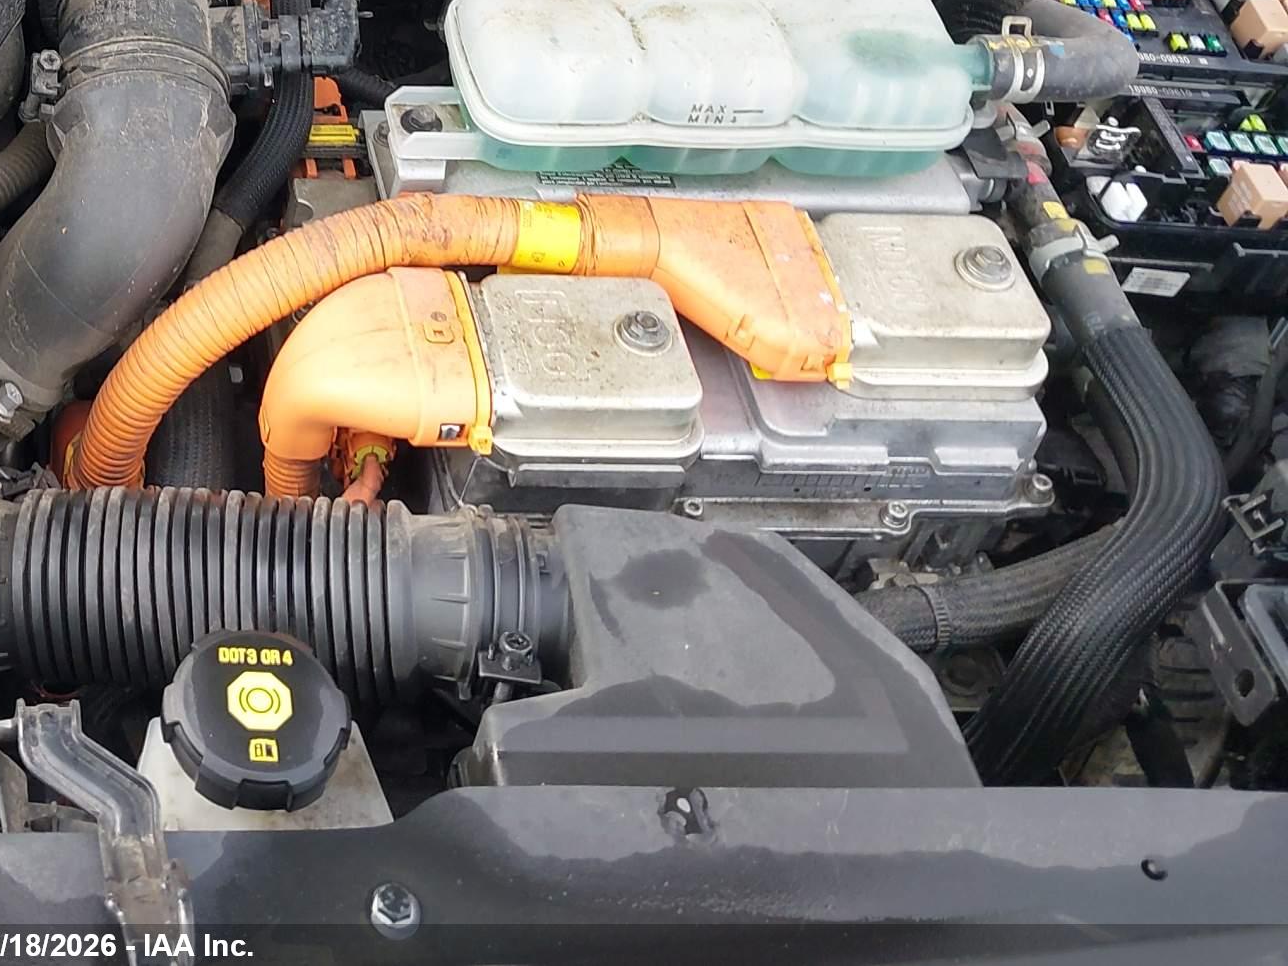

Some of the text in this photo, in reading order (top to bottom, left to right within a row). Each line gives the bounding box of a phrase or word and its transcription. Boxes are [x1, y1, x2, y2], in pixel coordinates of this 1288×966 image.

[691, 104, 727, 114] MAX
[687, 114, 724, 124] MIN
[260, 648, 281, 666] OR
[282, 650, 293, 666] 4
